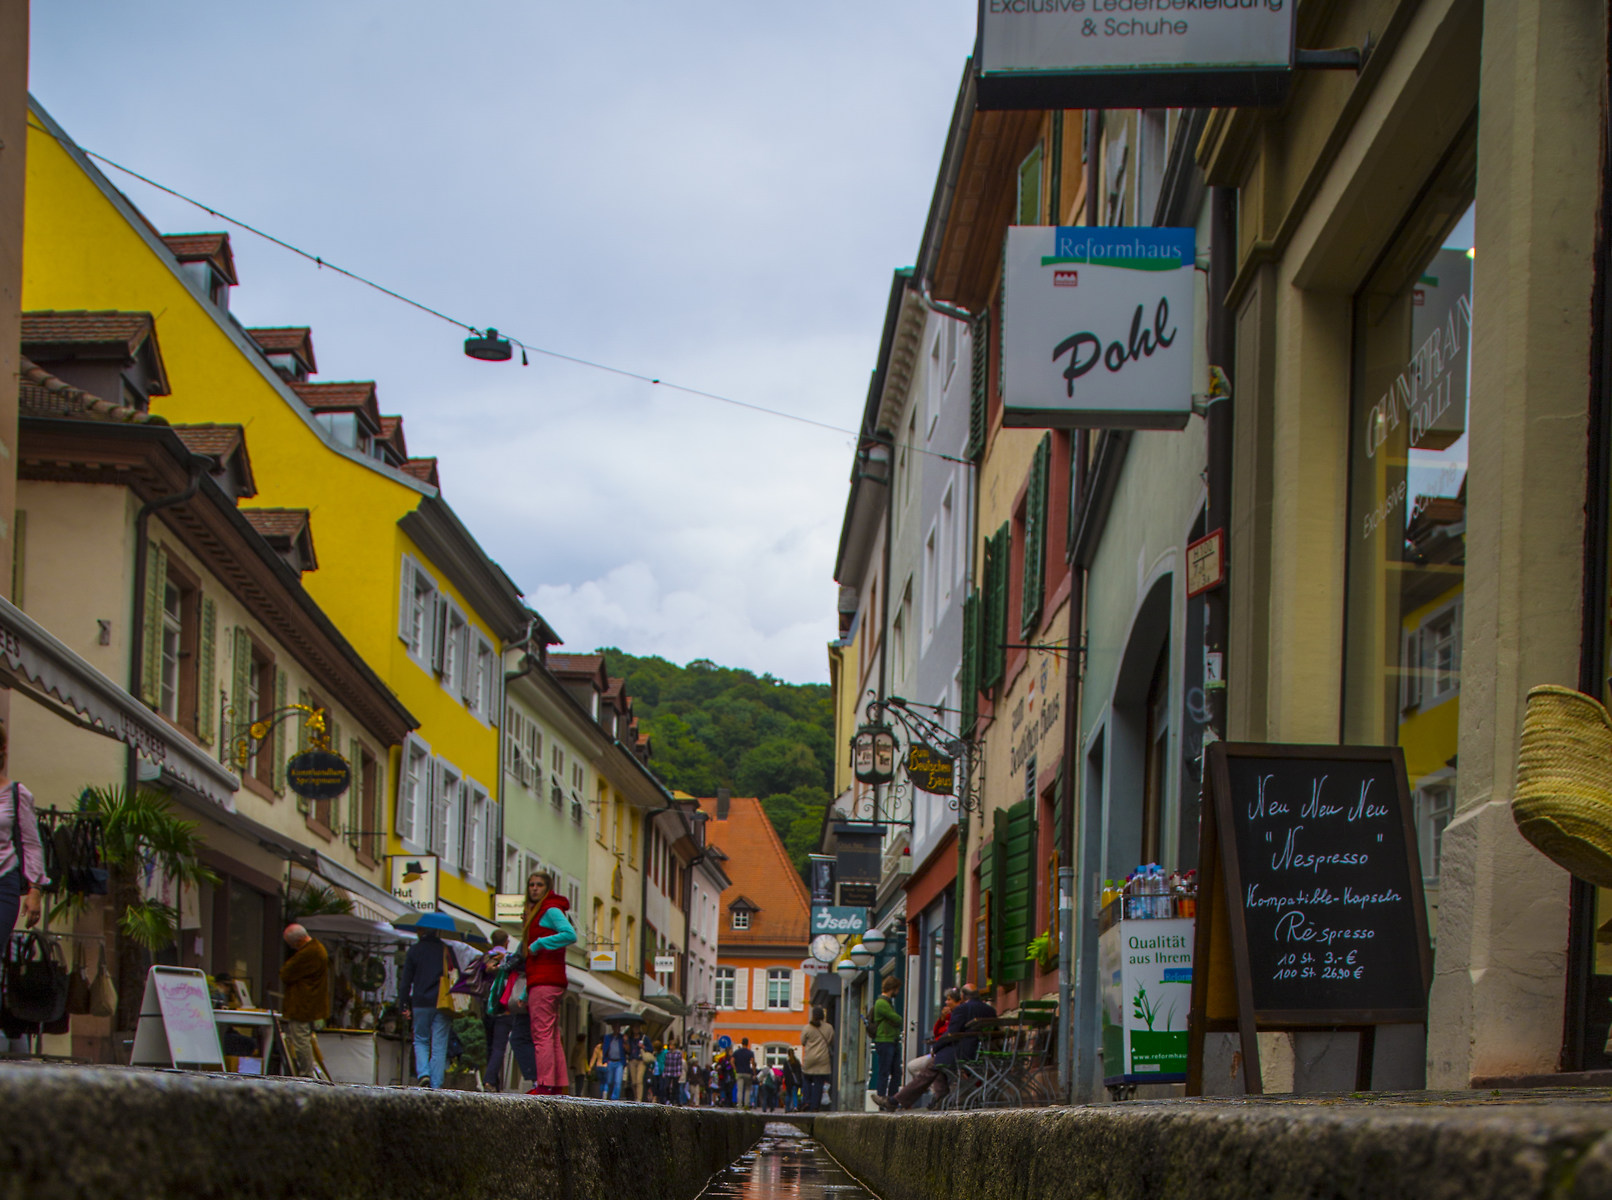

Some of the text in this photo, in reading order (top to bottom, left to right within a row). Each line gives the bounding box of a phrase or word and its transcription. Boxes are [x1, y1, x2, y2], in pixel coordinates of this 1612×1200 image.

[989, 0, 1284, 13] Exclusive Lederbekleidung
[1080, 17, 1188, 37] & Schuhe
[1060, 237, 1183, 264] Reformhaus
[1052, 296, 1177, 398] Pohl
[1248, 774, 1389, 822] Neu Neu Neu
[393, 888, 411, 898] Hut
[1128, 935, 1187, 950] Qualität
[1129, 952, 1192, 965] aus Ihrem
[1277, 952, 1297, 966] 10
[1272, 967, 1299, 981] 100
